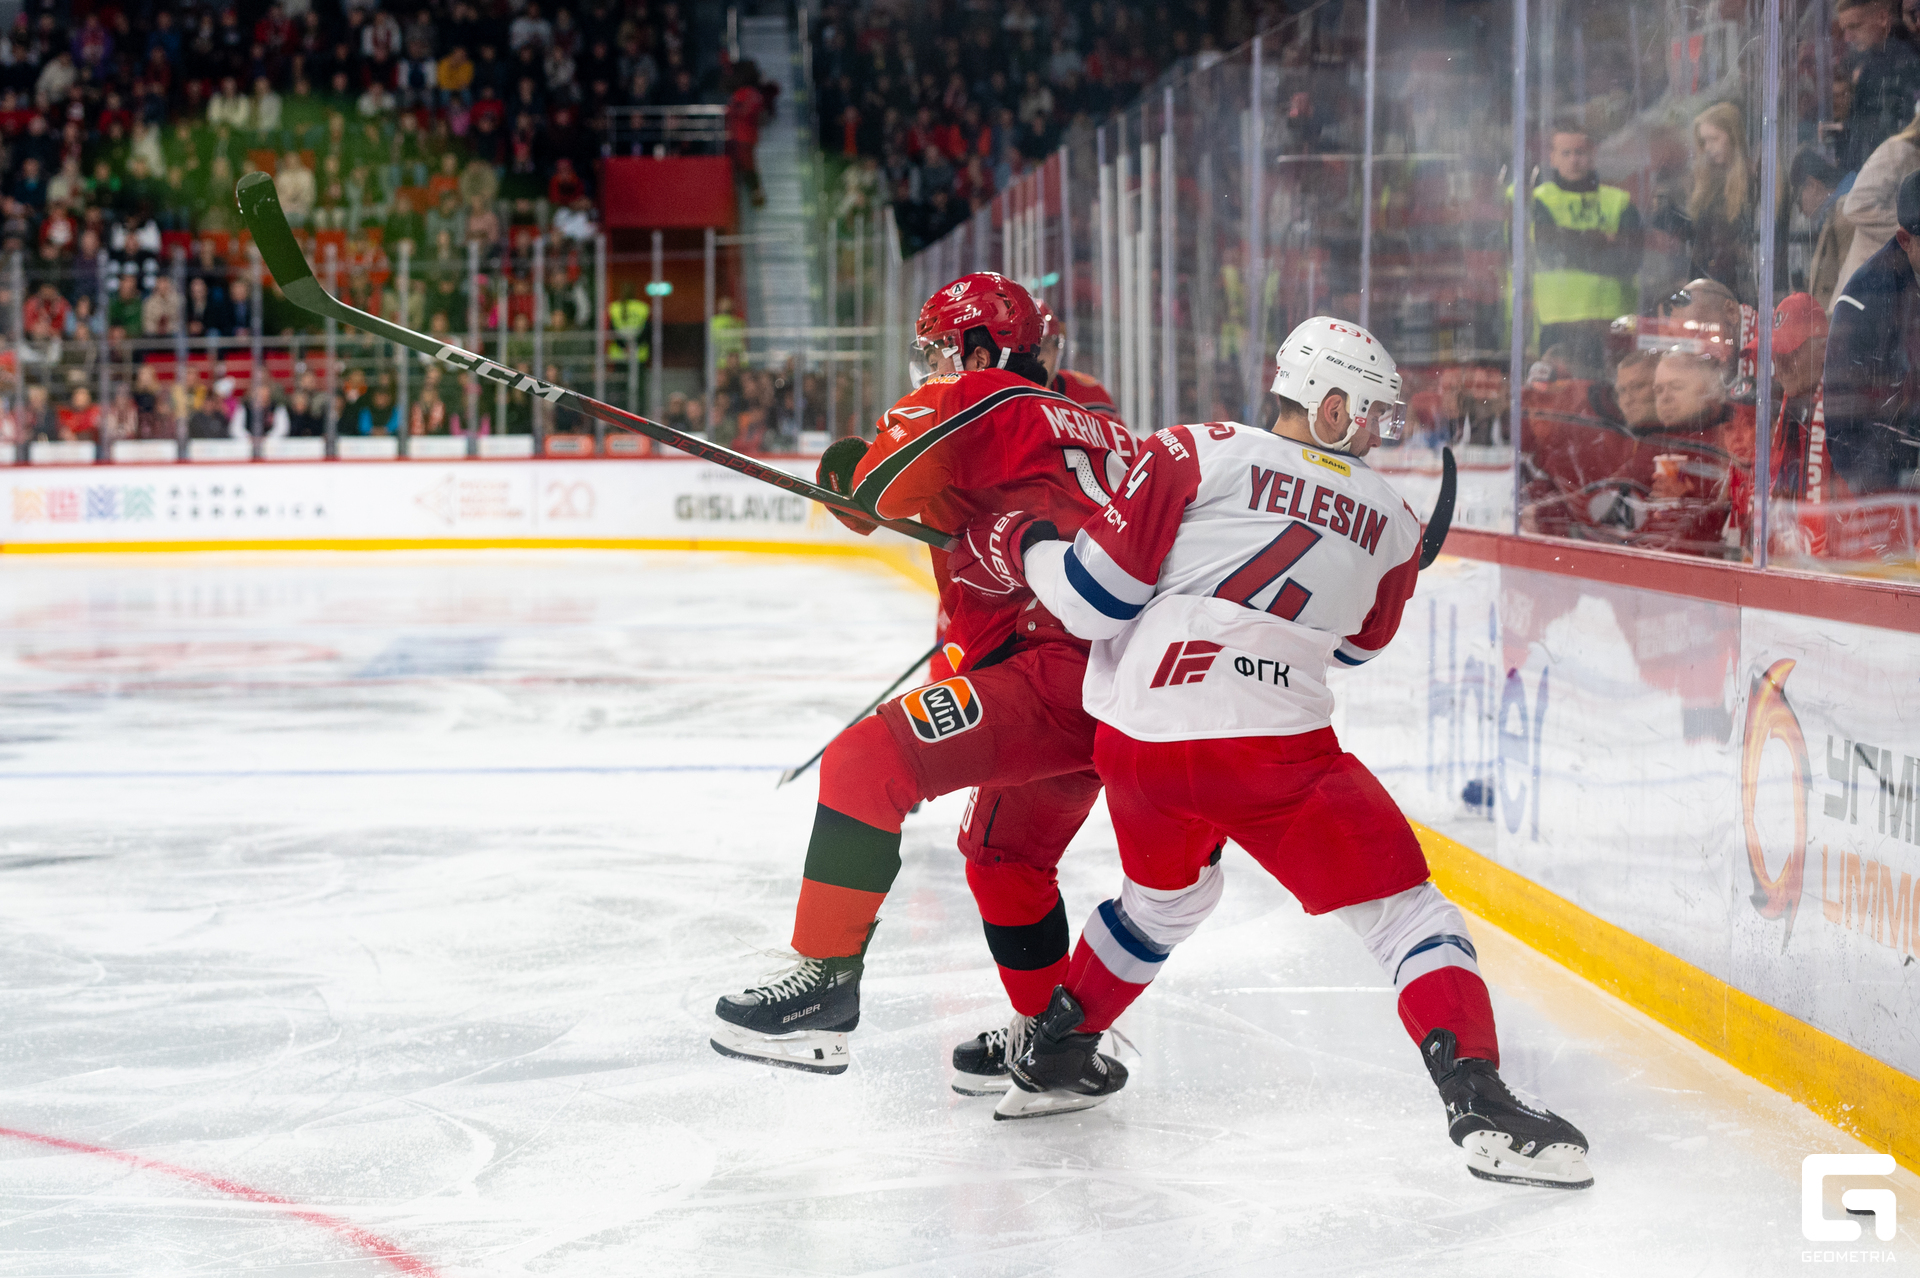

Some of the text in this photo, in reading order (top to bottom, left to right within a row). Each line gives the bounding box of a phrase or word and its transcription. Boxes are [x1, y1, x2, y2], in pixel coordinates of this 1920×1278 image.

[953, 309, 982, 324] CCM
[435, 345, 566, 402] CCM
[1325, 355, 1363, 374] BAUER
[661, 435, 795, 488] JETSPEED
[1155, 427, 1190, 461] NBET
[1124, 450, 1155, 500] 4
[674, 496, 807, 522] GISLAVED
[1248, 464, 1389, 556] YELESIN
[1212, 520, 1323, 623] 4
[1234, 656, 1290, 688] ФГК
[1824, 734, 1920, 847] УГМ
[782, 1003, 821, 1024] BAUER
